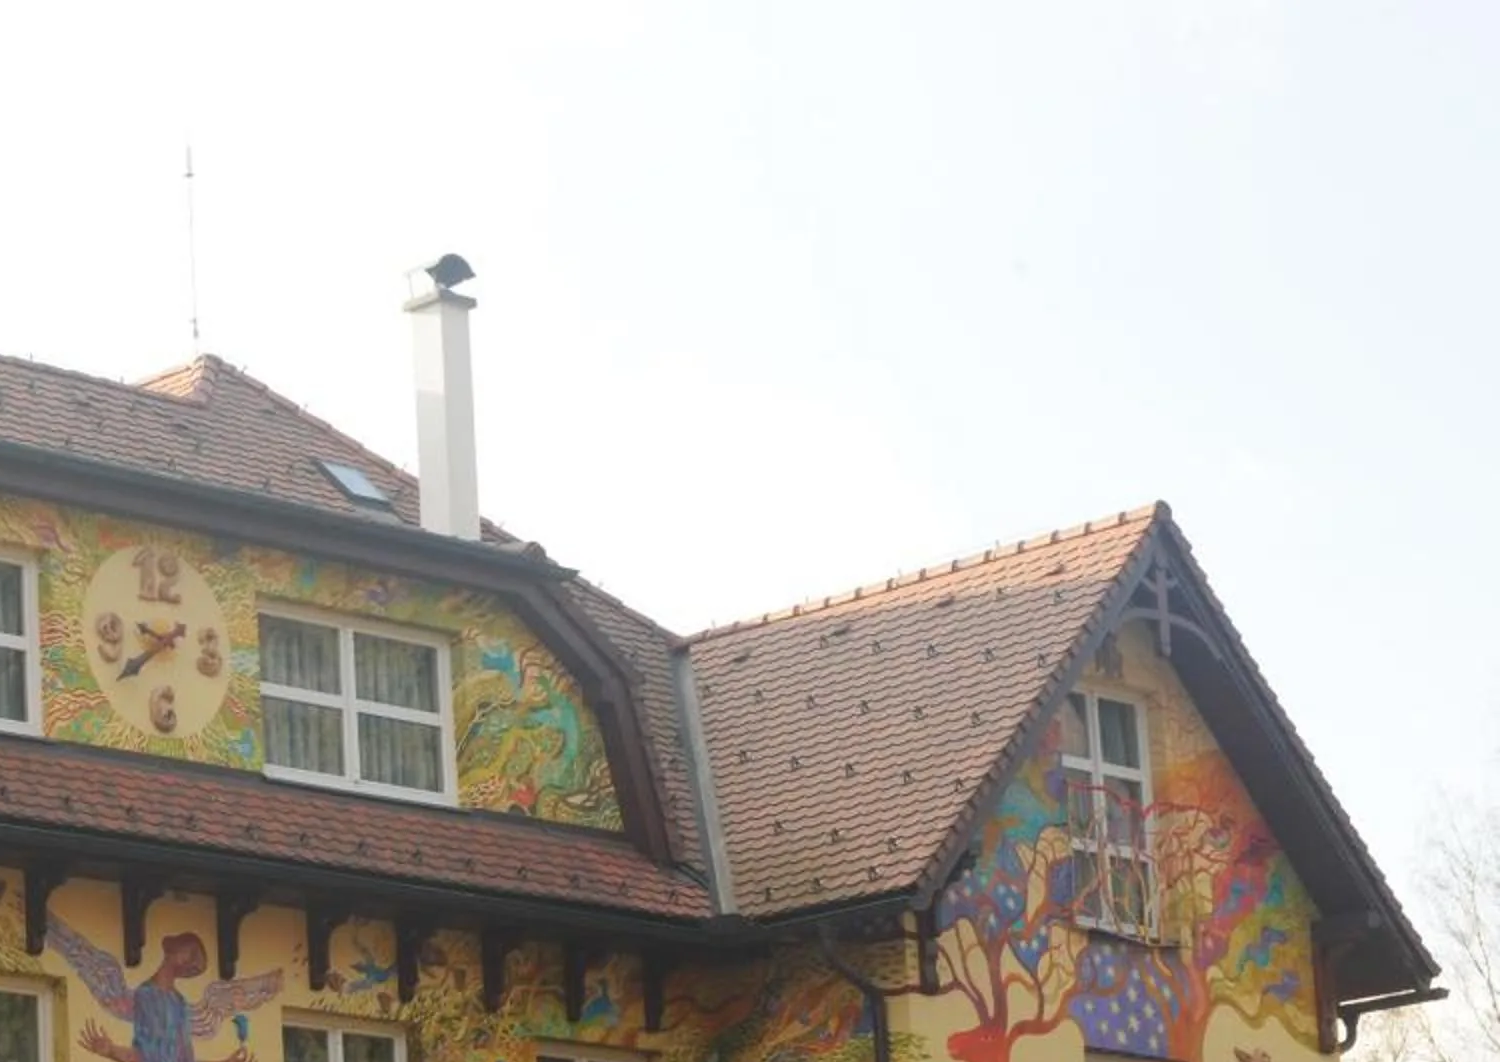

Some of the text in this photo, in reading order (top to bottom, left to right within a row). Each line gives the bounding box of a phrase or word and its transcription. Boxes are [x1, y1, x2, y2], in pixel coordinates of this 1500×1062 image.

[132, 546, 182, 605] 12
[95, 612, 125, 663] 9
[197, 626, 222, 678] 3
[149, 685, 177, 733] 6
